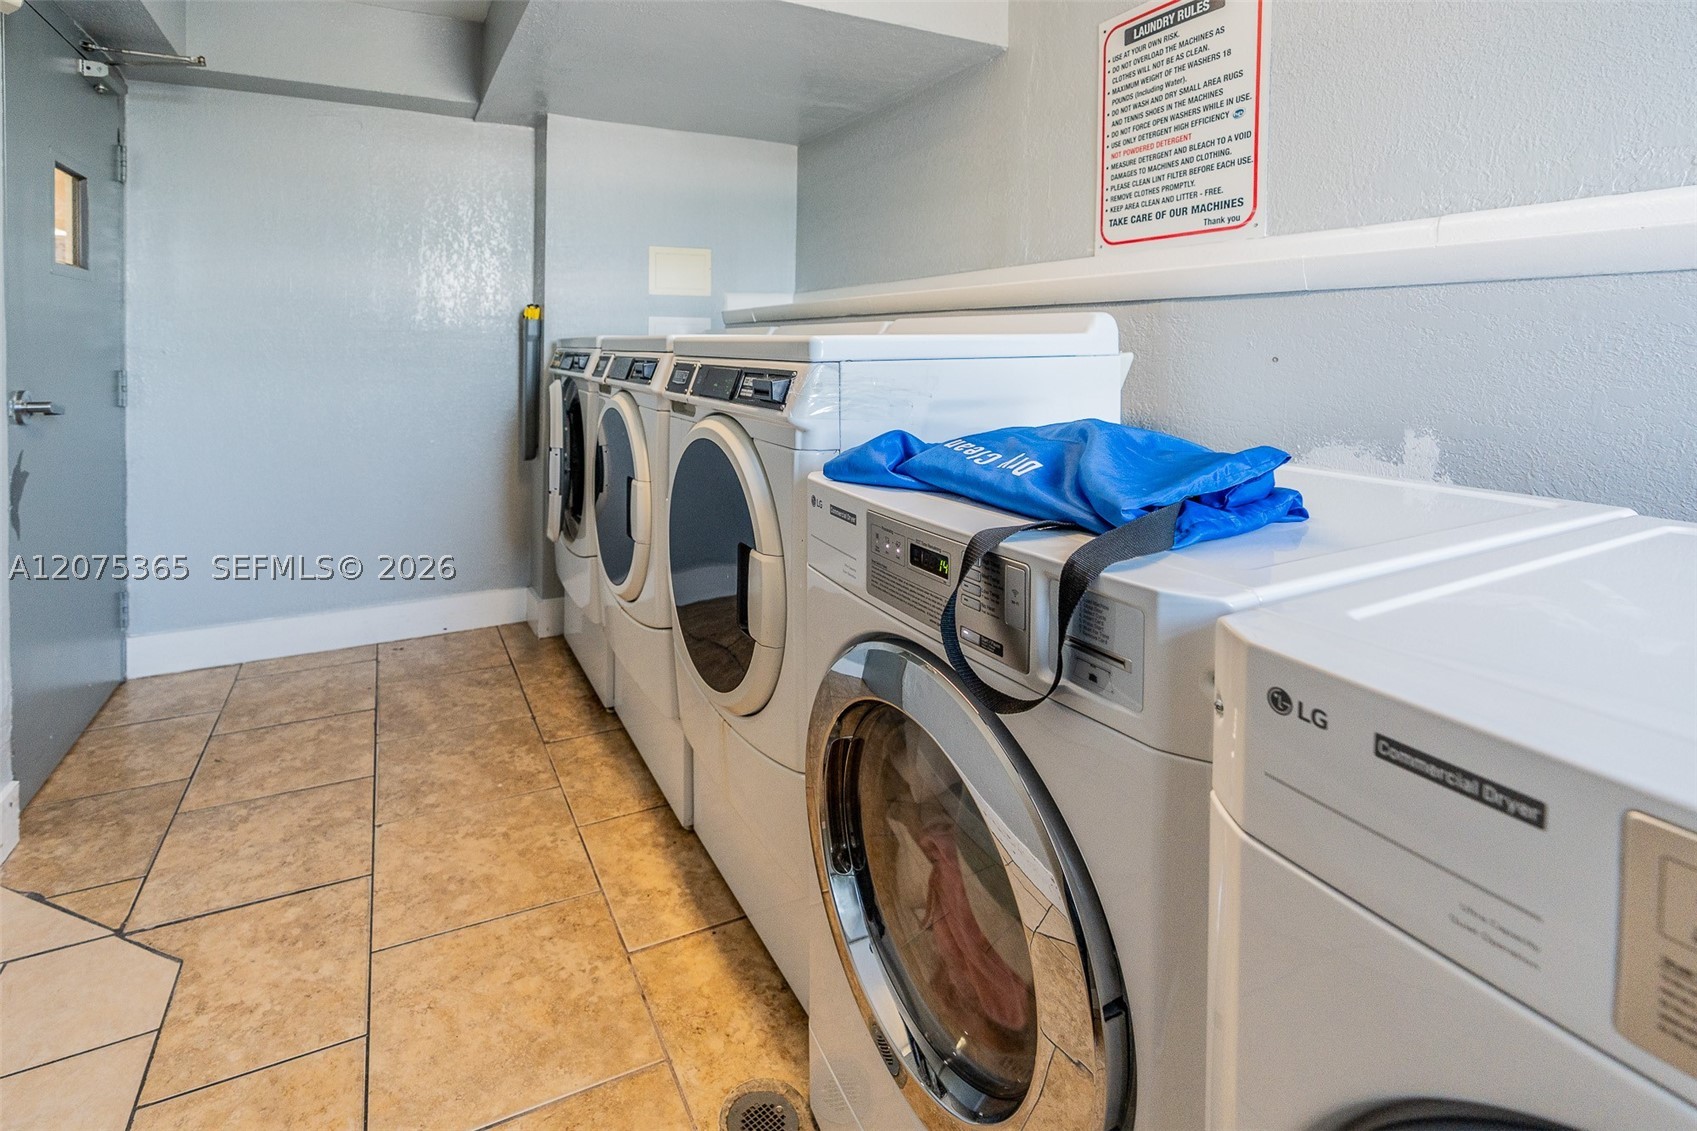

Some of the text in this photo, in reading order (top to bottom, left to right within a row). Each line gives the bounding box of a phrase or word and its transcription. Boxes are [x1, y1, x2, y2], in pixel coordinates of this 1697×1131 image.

[1134, 0, 1210, 40] LAUNDRY RULES
[1112, 43, 1209, 84] CLOTHES WILL NOT BE AS CLEAN.
[1113, 30, 1179, 63] USE AT YOUR OWN RISK.
[1113, 25, 1225, 74] DO NOT OVERLOAD THE MACHINES AS
[1112, 48, 1231, 95] MAXIMUM WEIGHT OF THE WASHERS 18
[1112, 75, 1187, 106] POUNDS (Including Water).
[1112, 69, 1243, 116] DO NOT WASH AND DRY SMALL AREA RUGS
[1112, 88, 1223, 127] AND TENNIS SHOES IN THE MACHINES
[1111, 140, 1121, 148] USE
[1122, 136, 1136, 146] ONLY
[1138, 126, 1172, 142] DETERGENT
[1174, 122, 1189, 132] HIGH
[1191, 111, 1229, 128] EFFICIENCY
[1112, 92, 1252, 138] DO NOT FORCE OPEN WASHERS WHILE IN USE.
[1111, 132, 1192, 159] NOT POWDERED DETERGENT
[1111, 130, 1251, 170] MEASURE DETERGENT AND BLEACH TO A VOID
[1111, 147, 1232, 181] DAMAGES TO MACHINES AND CLOTHING.
[1110, 179, 1195, 202] REMOVE CLOTHES PROMPTLY.
[1111, 155, 1253, 192] PLEASE CLEAN LINT FILTER BEFORE EACH USE.
[1109, 197, 1244, 227] TAKE CARE OF OUR MACHINES
[1110, 205, 1123, 213] KEEP
[1125, 202, 1139, 210] AREA
[1141, 198, 1160, 208] CLEAN
[1162, 195, 1174, 204] AND
[1176, 191, 1198, 201] LITTER
[1205, 186, 1223, 196] FREE.
[1204, 216, 1224, 226] Thank
[944, 439, 1044, 476] Dry Clean
[816, 499, 822, 509] LG
[939, 560, 948, 574] 14
[1298, 701, 1328, 730] LG
[1376, 740, 1542, 820] Commercial Dryer
